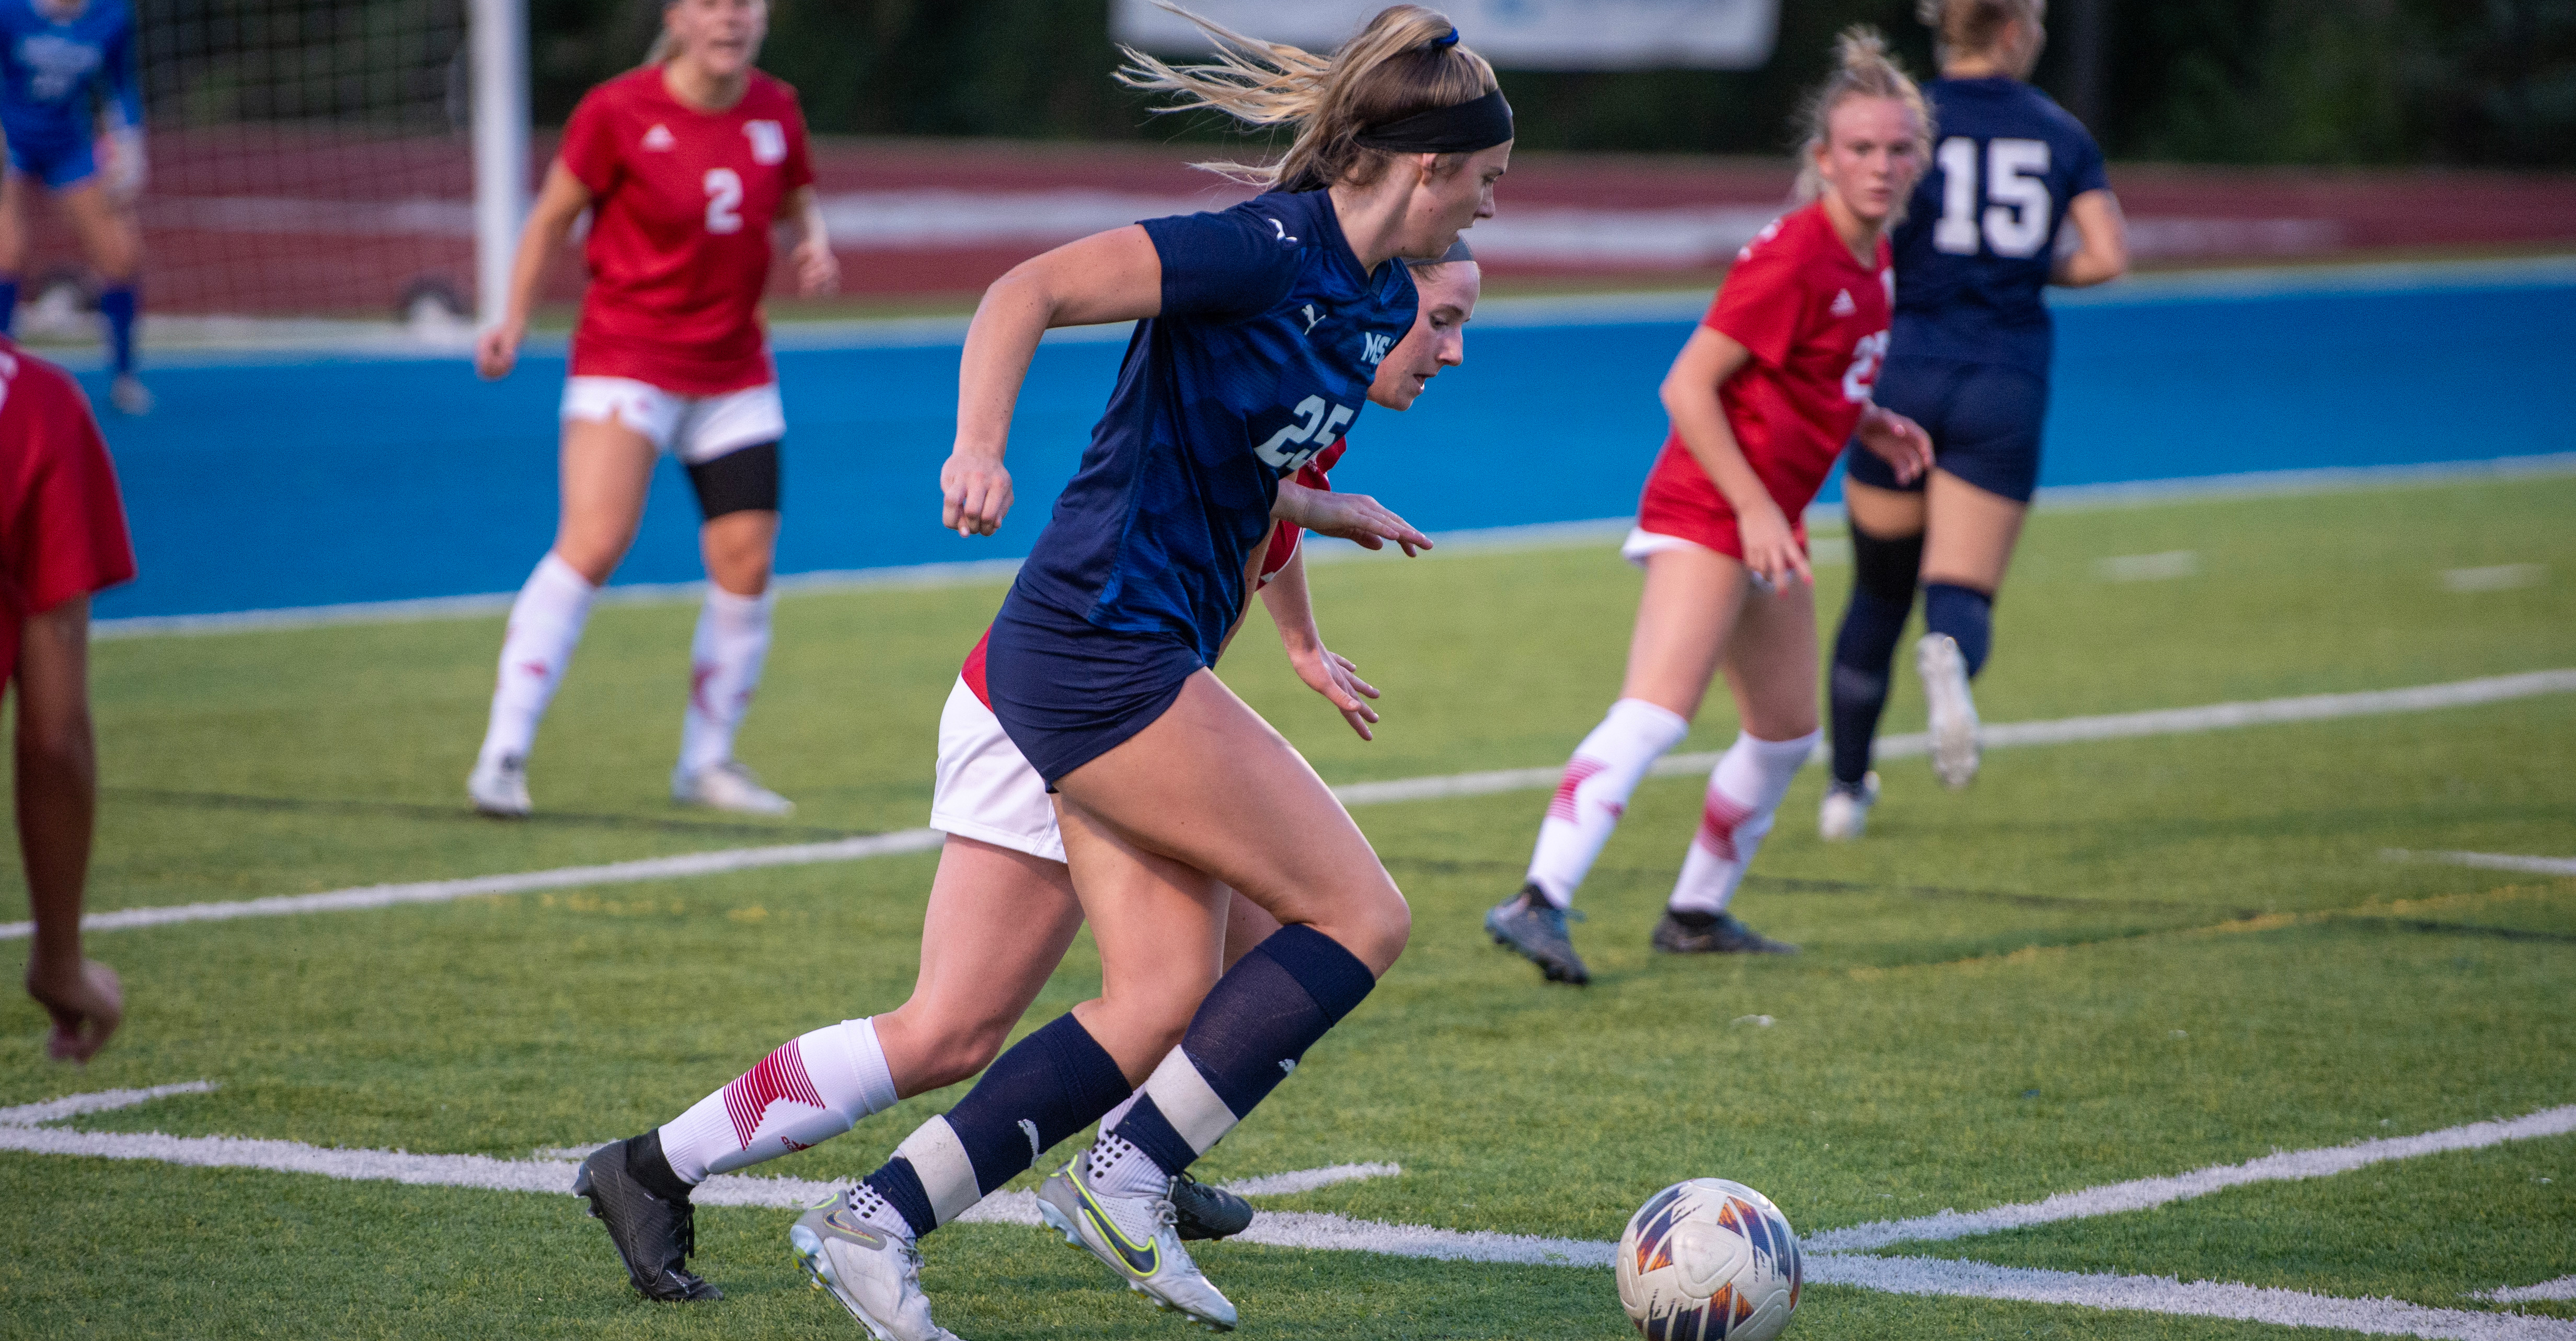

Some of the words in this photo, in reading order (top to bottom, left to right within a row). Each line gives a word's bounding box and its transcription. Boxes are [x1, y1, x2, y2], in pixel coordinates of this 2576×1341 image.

[704, 167, 743, 234] 2
[1933, 135, 2052, 259] 15
[1361, 331, 1397, 365] MS
[1254, 395, 1354, 470] 25
